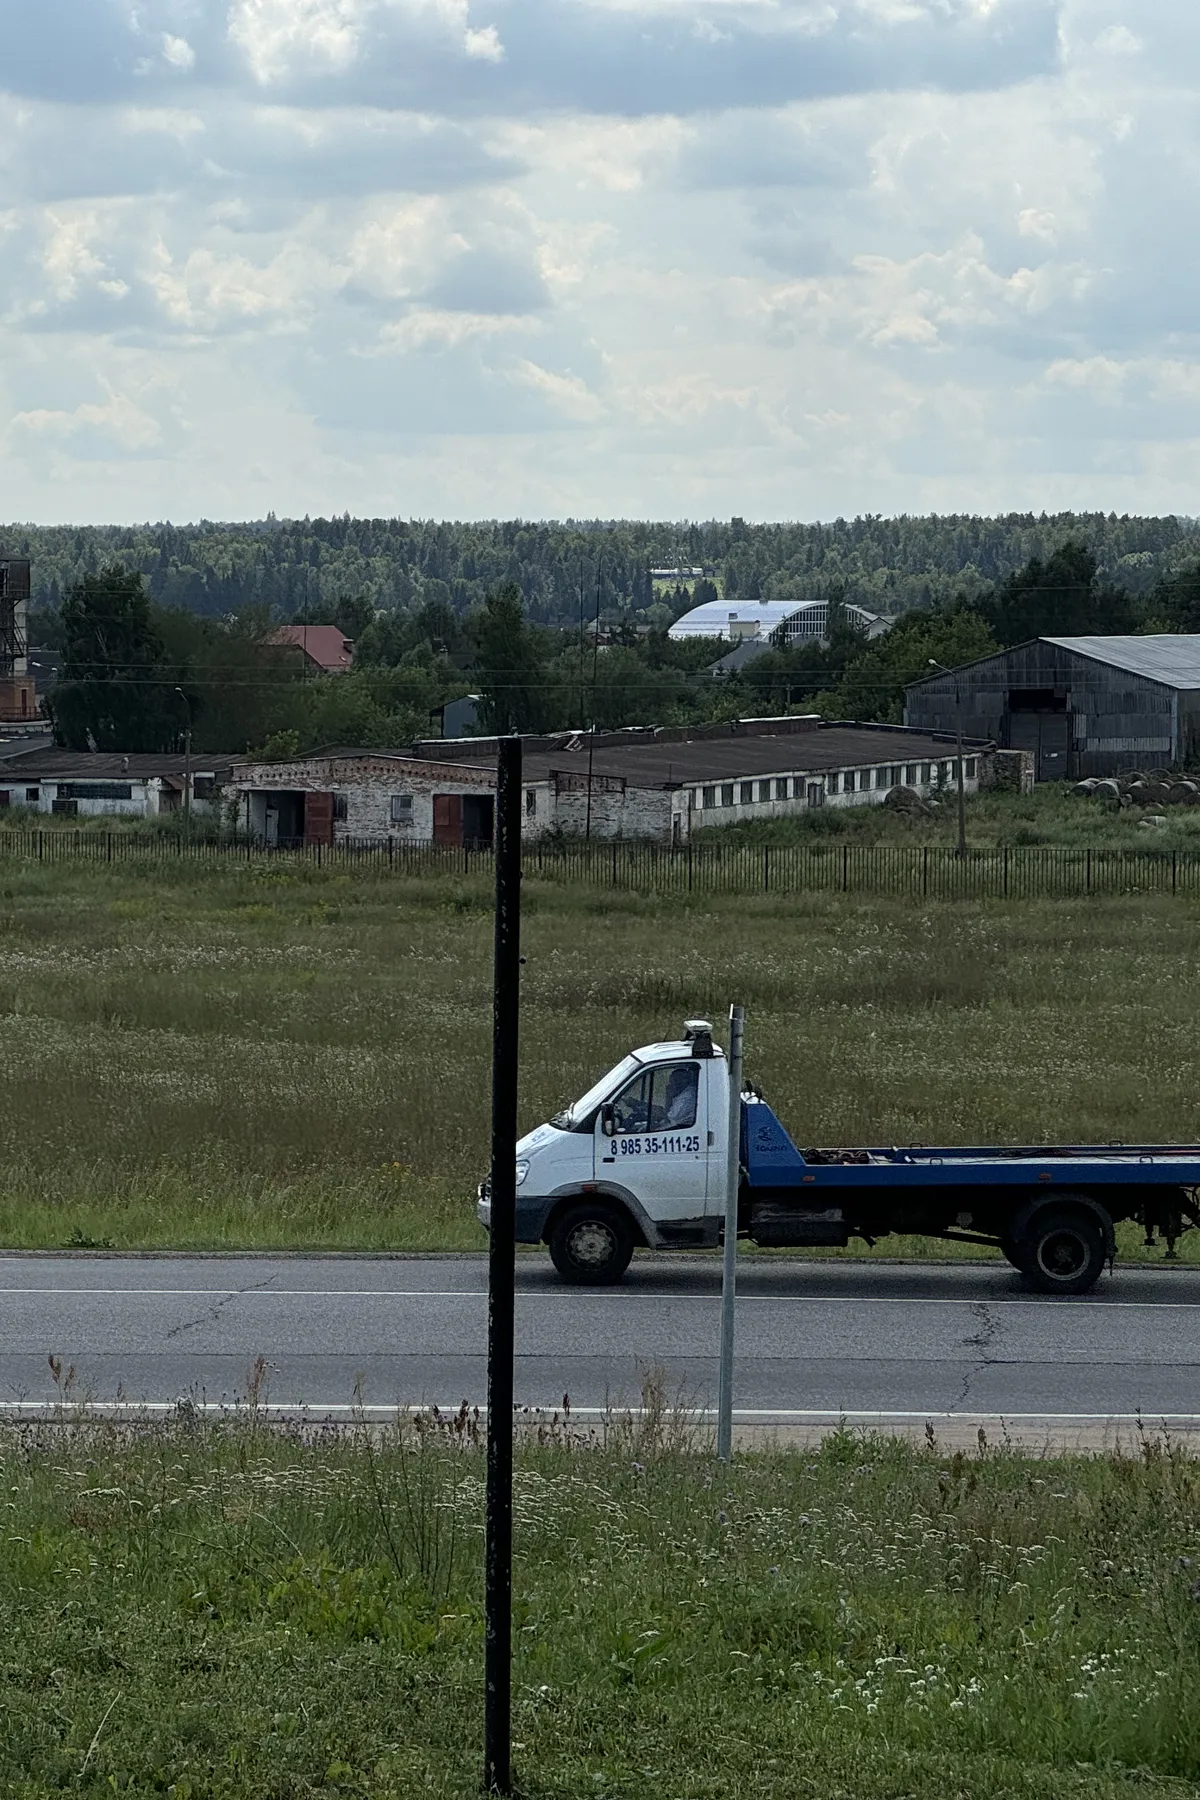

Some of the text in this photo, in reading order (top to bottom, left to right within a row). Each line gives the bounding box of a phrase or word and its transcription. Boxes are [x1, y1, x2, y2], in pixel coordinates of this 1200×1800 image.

[611, 1136, 699, 1155] 8 985 35-111-25
